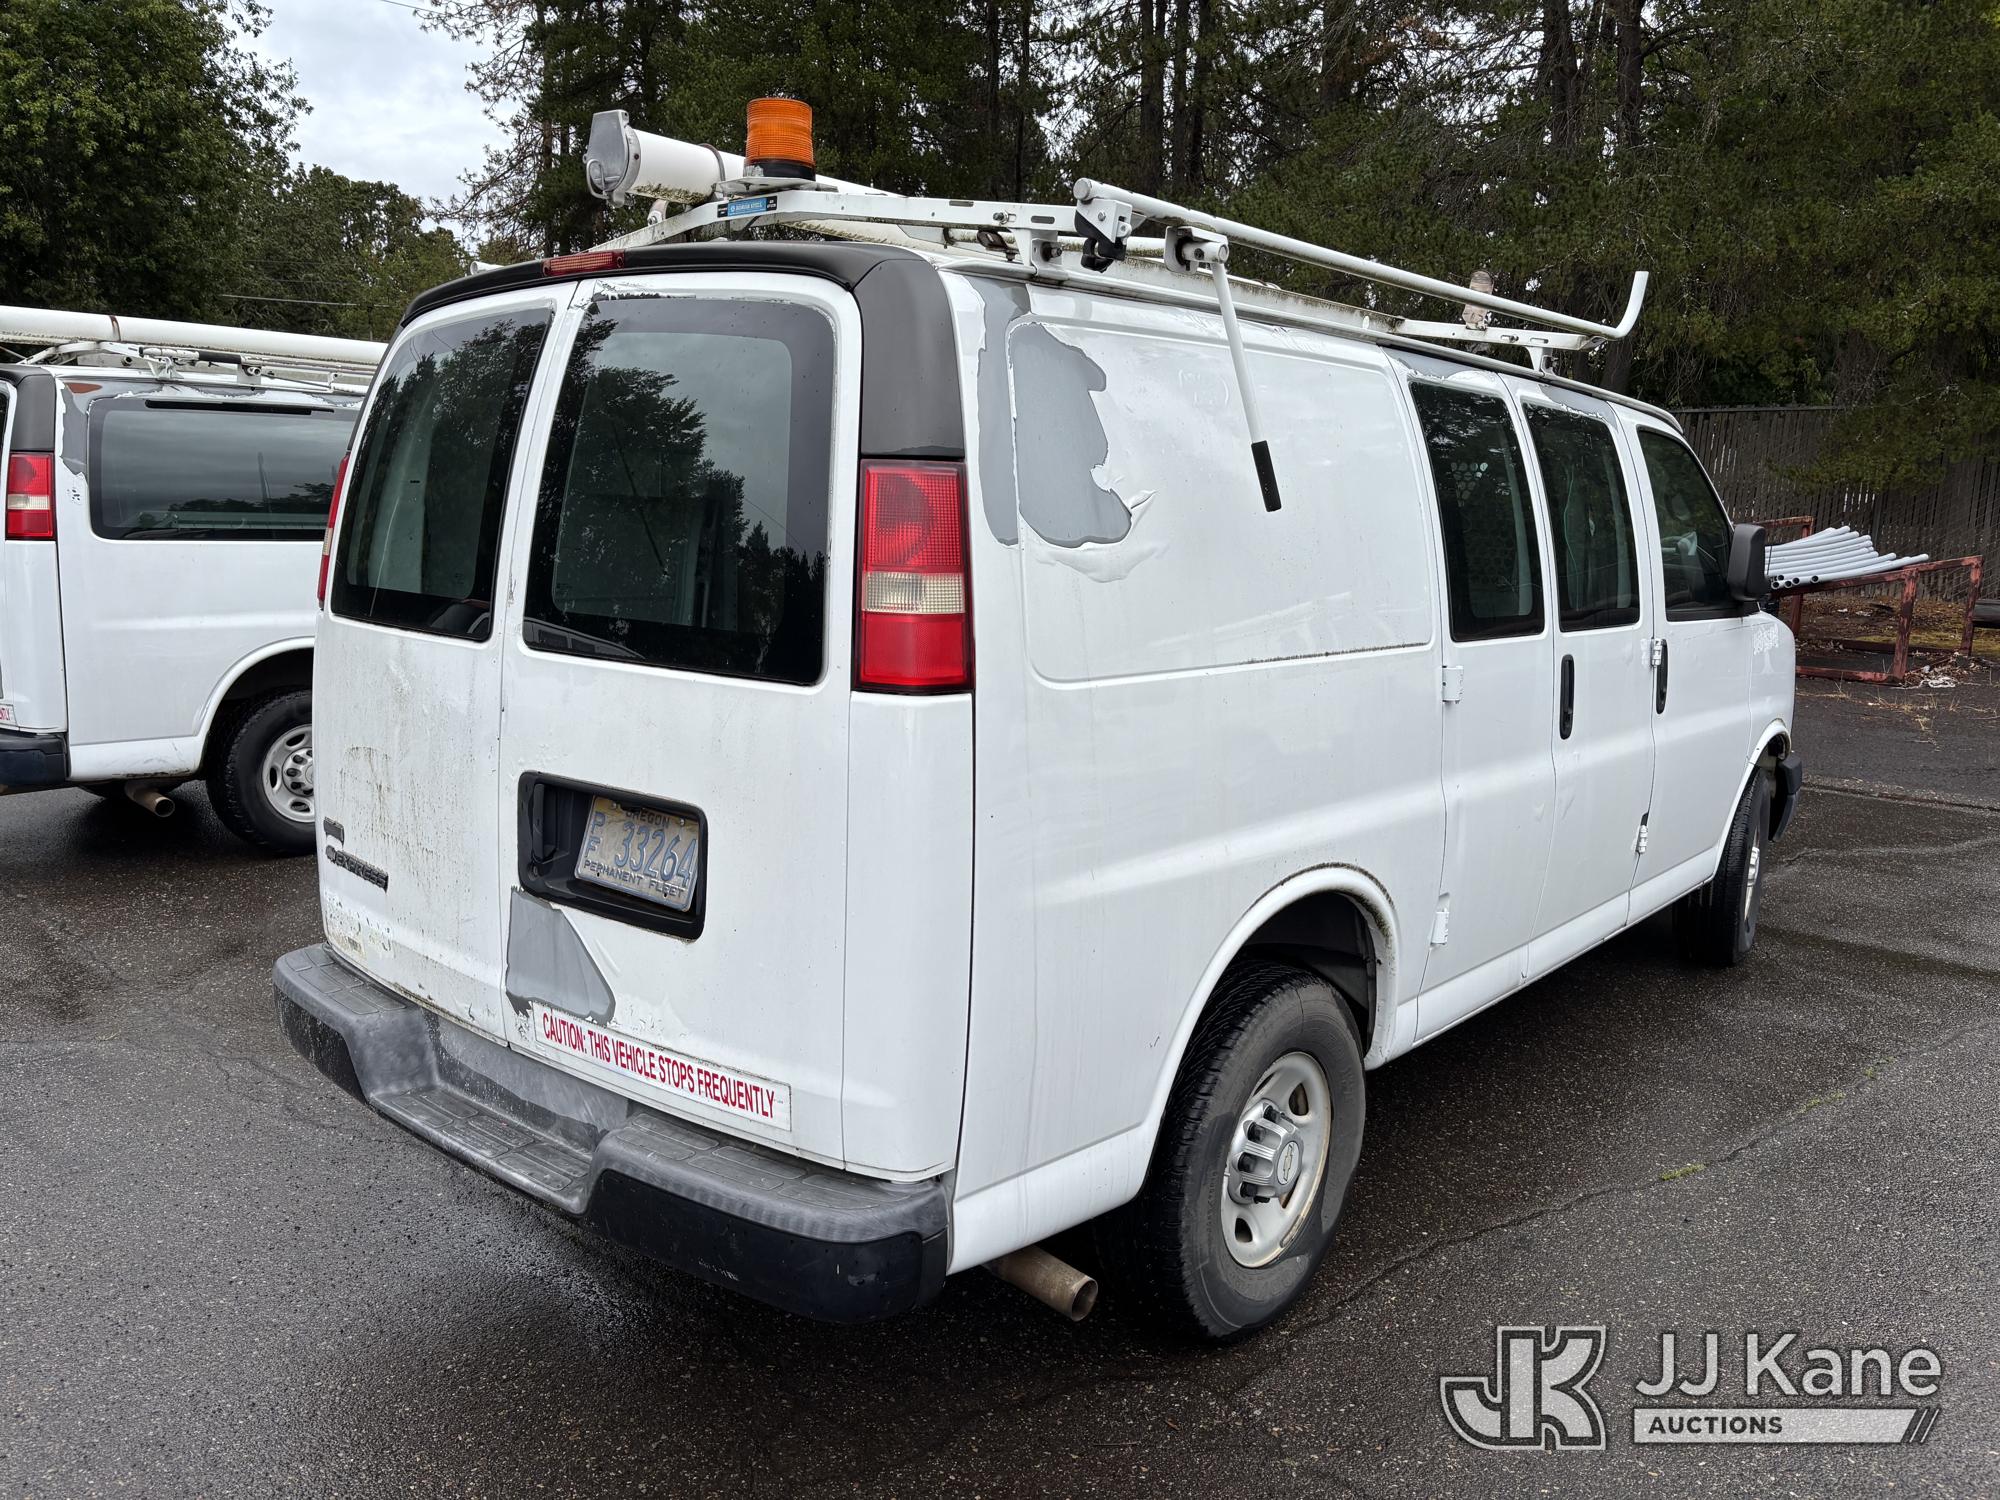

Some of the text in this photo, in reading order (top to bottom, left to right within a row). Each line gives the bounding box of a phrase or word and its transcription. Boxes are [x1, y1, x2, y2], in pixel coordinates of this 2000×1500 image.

[584, 860, 686, 898] PERMANENT FLEET
[614, 821, 697, 888] 33264
[543, 1012, 776, 1119] CAUTION: THIS VEHICLE STOPS FREQUENTLY
